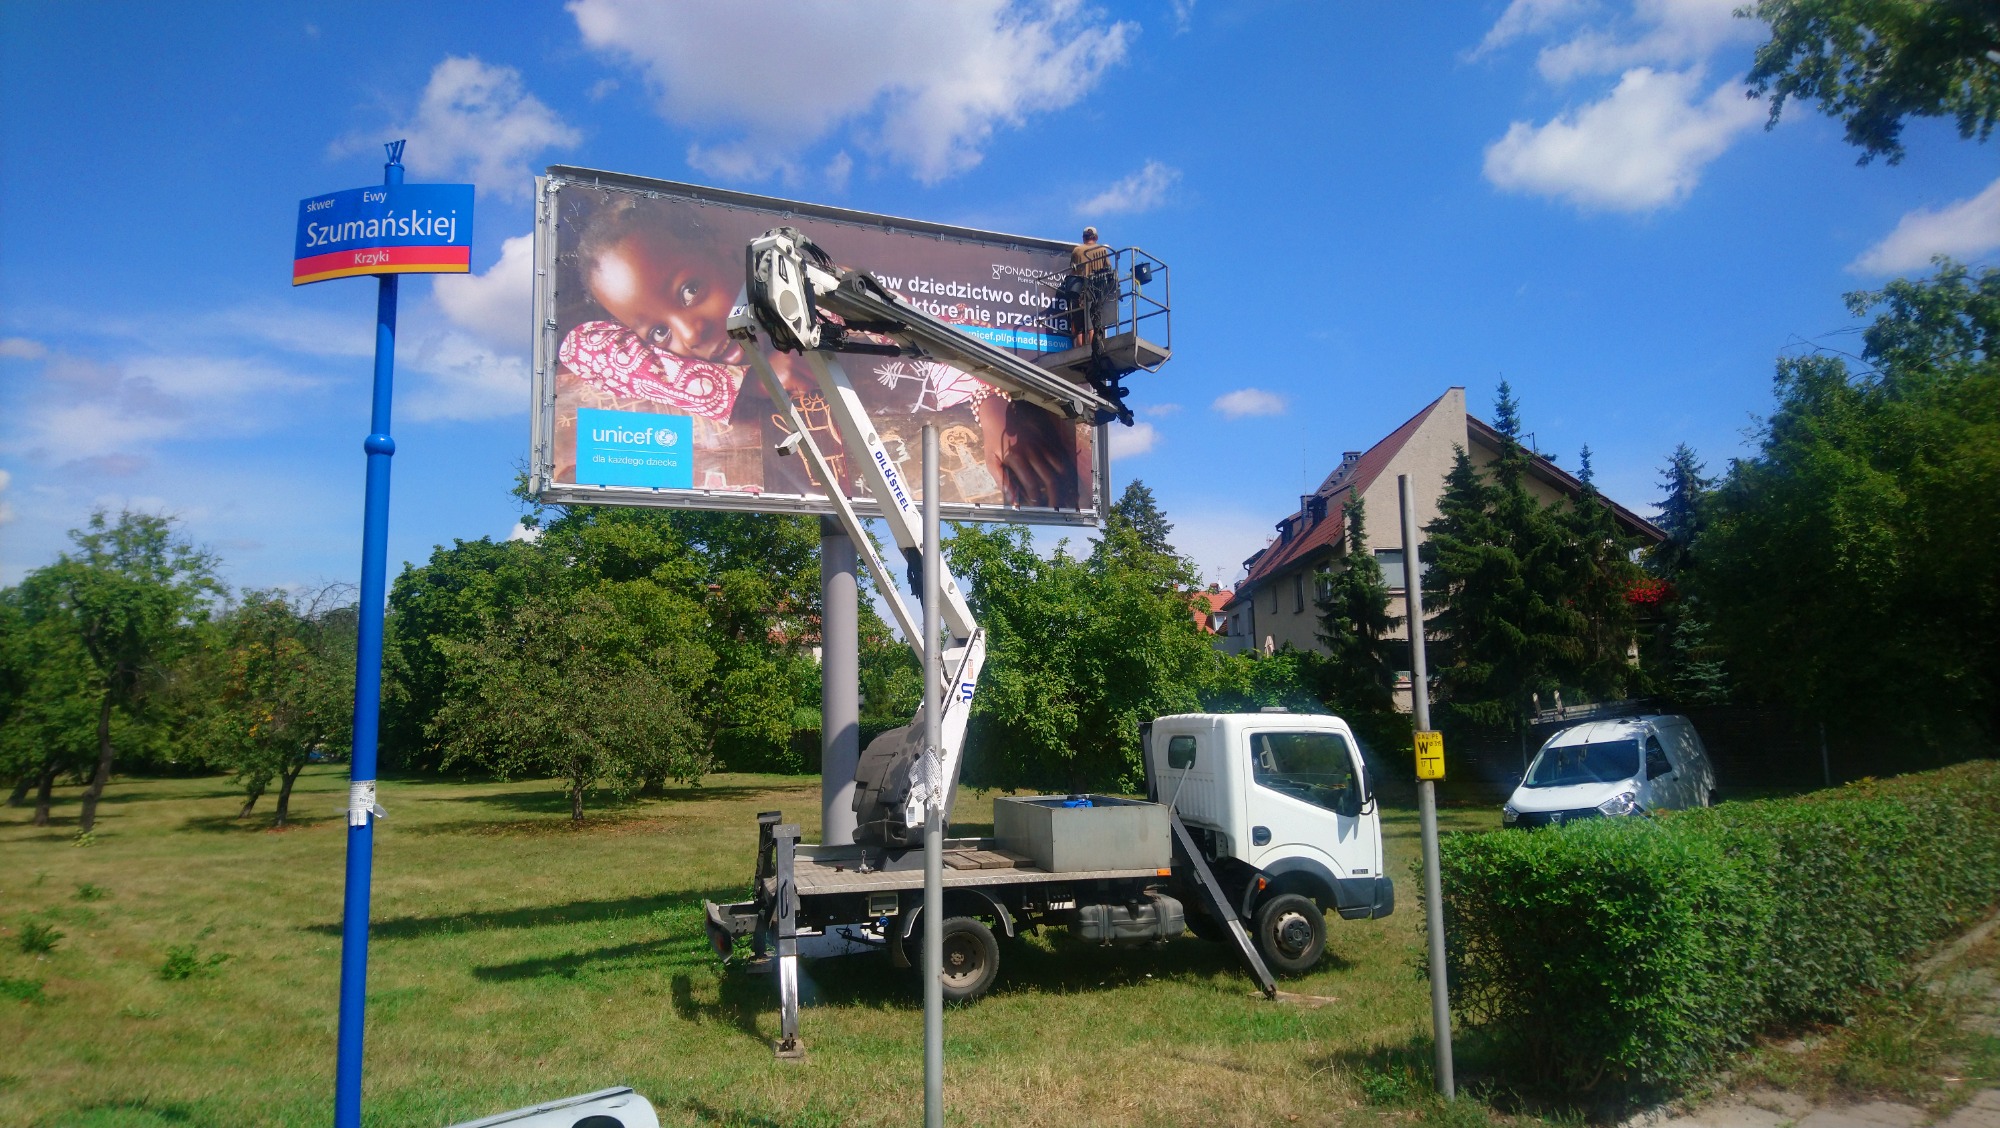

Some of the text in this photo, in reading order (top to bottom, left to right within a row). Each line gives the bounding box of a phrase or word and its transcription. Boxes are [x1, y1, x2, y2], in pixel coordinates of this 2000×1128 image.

[307, 191, 387, 213] skwer Ewy
[306, 209, 456, 248] Szumańskiej
[354, 250, 389, 266] Krzyki
[908, 276, 1014, 304] dziedzictwo
[912, 297, 958, 318] które
[964, 305, 991, 322] nie
[592, 425, 653, 445] unicef
[592, 454, 605, 463] dla
[646, 458, 677, 467] dziecka
[1417, 741, 1428, 755] W
